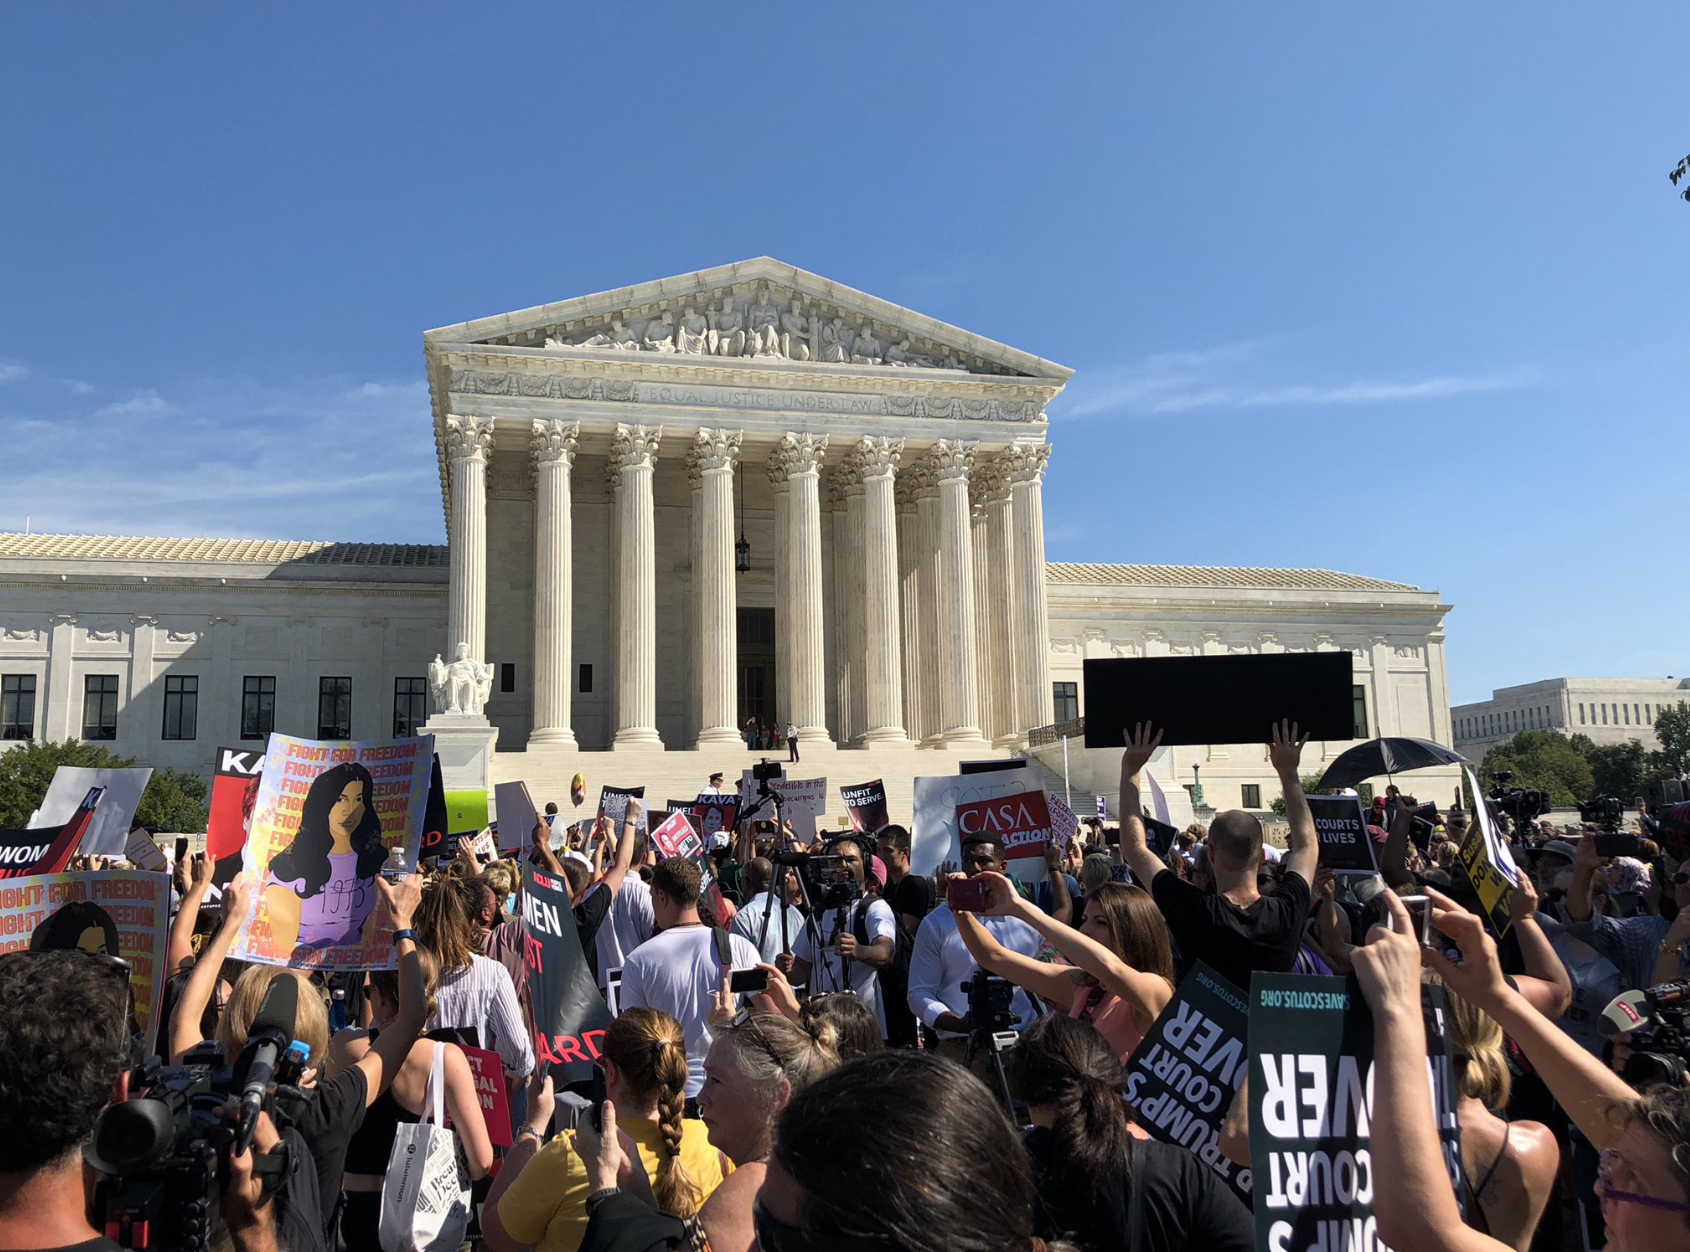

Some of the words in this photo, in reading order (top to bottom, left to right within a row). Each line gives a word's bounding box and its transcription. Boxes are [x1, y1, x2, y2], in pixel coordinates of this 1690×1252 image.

[650, 387, 706, 403] EQUAL
[712, 391, 774, 408] JUSTICE
[782, 396, 839, 410] UNDER
[841, 398, 872, 412] LAW
[287, 743, 330, 760] FIGHT
[331, 747, 357, 763] FOR
[359, 742, 417, 762] FREEDOM
[365, 761, 415, 779] REEDOM
[280, 777, 312, 796] FIGH
[842, 787, 871, 800] UNFIT
[844, 798, 856, 808] TO
[959, 801, 1038, 834] CASA
[1315, 818, 1360, 830] COURTS
[1322, 832, 1356, 844] LIVES
[0, 884, 43, 910] IGHT
[48, 879, 87, 903] FOR
[1196, 972, 1252, 1018] VESCOTUS.ORG
[1138, 1042, 1223, 1114] COURT
